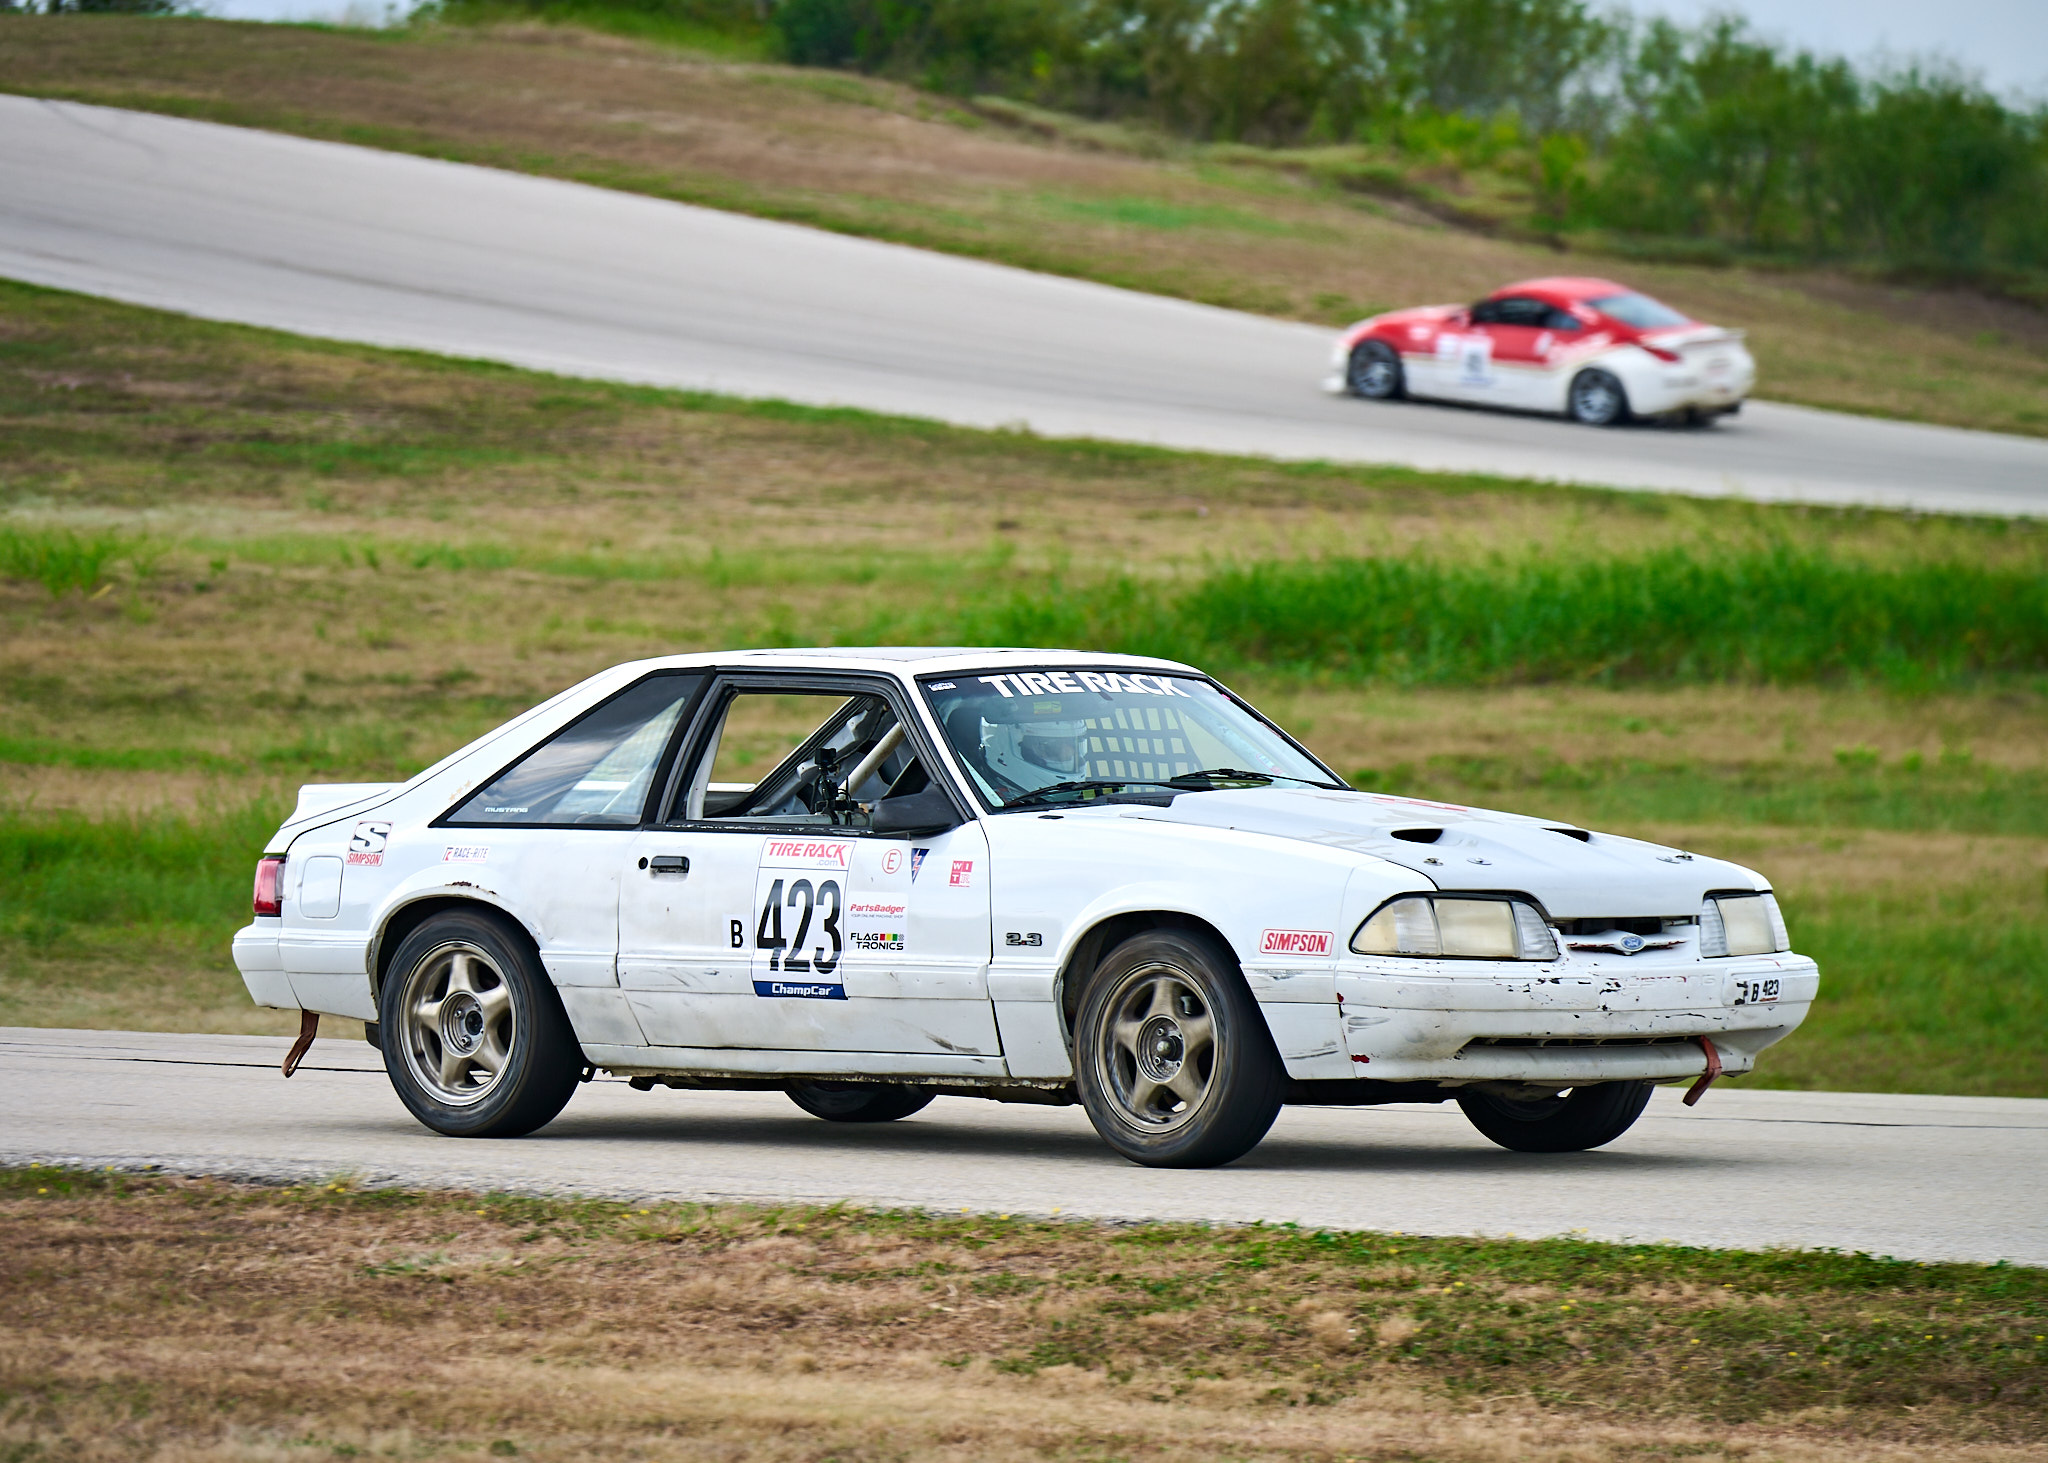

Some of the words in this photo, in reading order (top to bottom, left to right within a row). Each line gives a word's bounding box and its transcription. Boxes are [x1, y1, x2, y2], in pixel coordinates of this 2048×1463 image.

[978, 672, 1085, 698] TIRE
[1075, 672, 1191, 698] RACK
[347, 852, 382, 865] SIMPSON
[769, 842, 805, 857] TIRE
[803, 843, 847, 867] RACK
[850, 903, 906, 915] PartsBadger
[730, 919, 744, 949] B
[756, 878, 842, 975] 423
[850, 932, 879, 941] FLAG
[1006, 932, 1043, 947] 2.3
[1265, 932, 1328, 953] SIMPSON
[856, 941, 904, 951] TRONICS
[771, 982, 832, 997] ChampCar
[1750, 983, 1760, 1002] B
[1762, 979, 1780, 996] 423
